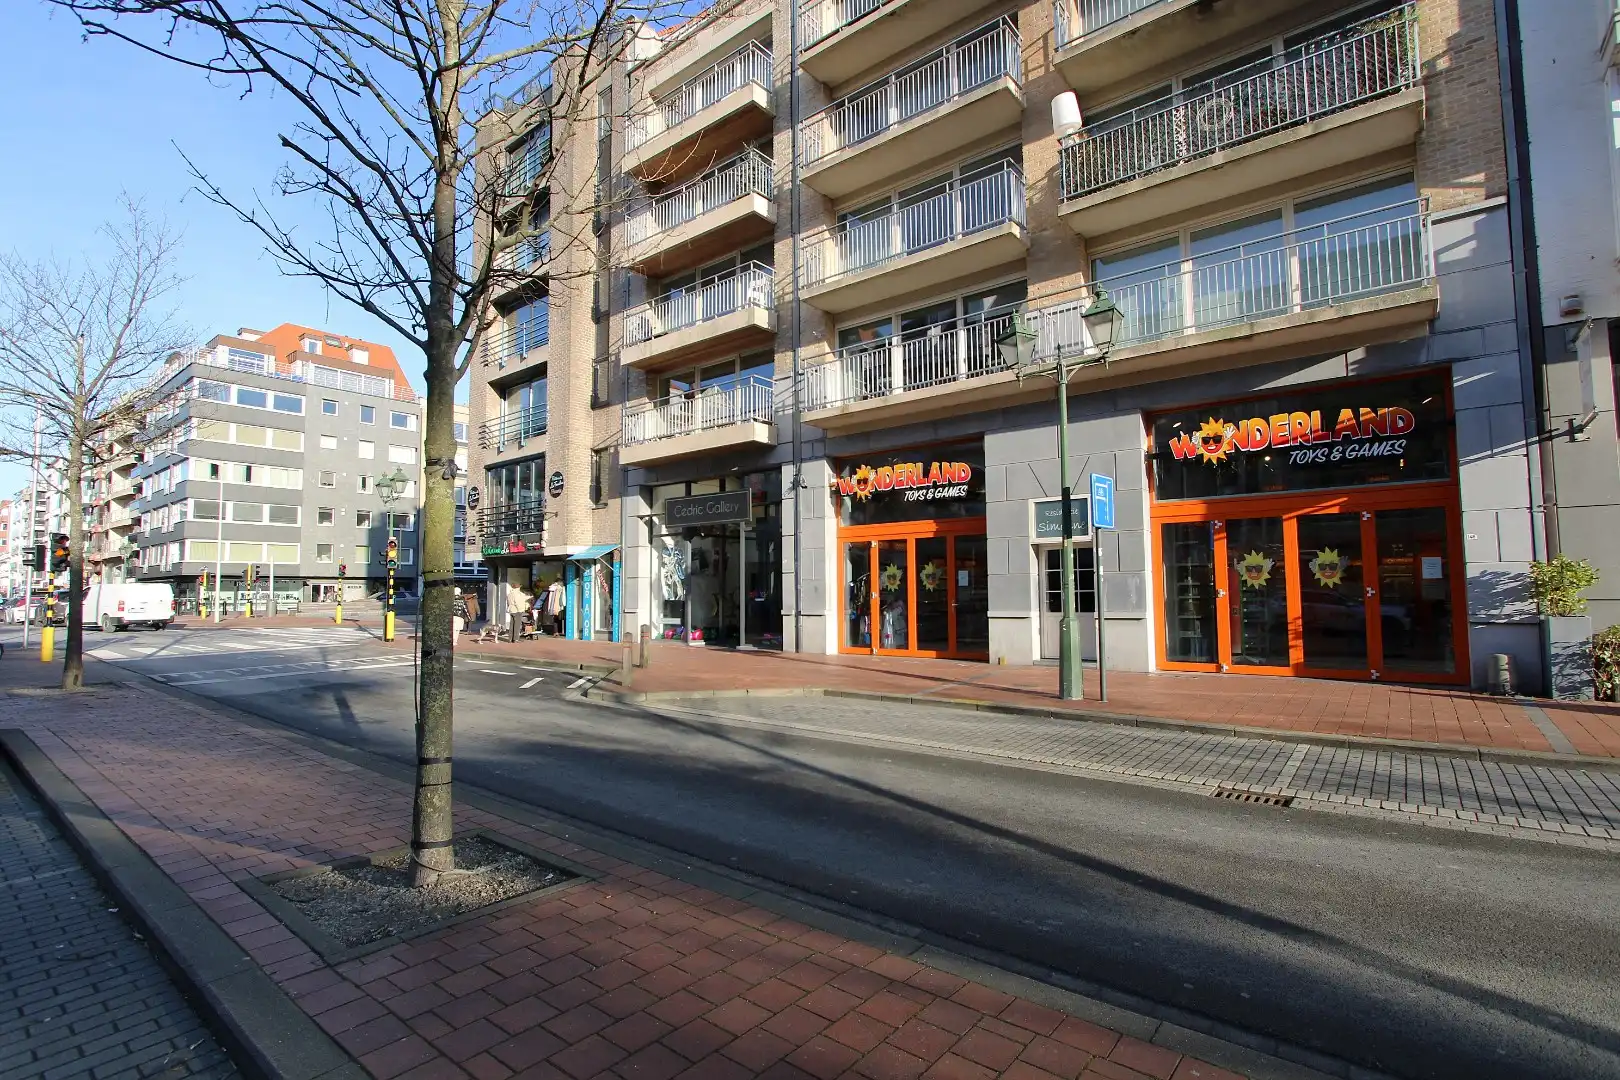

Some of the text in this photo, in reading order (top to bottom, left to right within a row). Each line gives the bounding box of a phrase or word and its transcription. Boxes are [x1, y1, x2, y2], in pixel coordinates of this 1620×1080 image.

[1168, 406, 1415, 463] WONDERLAND
[1289, 440, 1406, 465] TOYS & GAMES
[837, 462, 972, 500] WONDERLAND
[904, 485, 968, 502] TOYS & GAMES
[674, 500, 739, 517] Cedric Gallery
[1037, 521, 1086, 532] Simne
